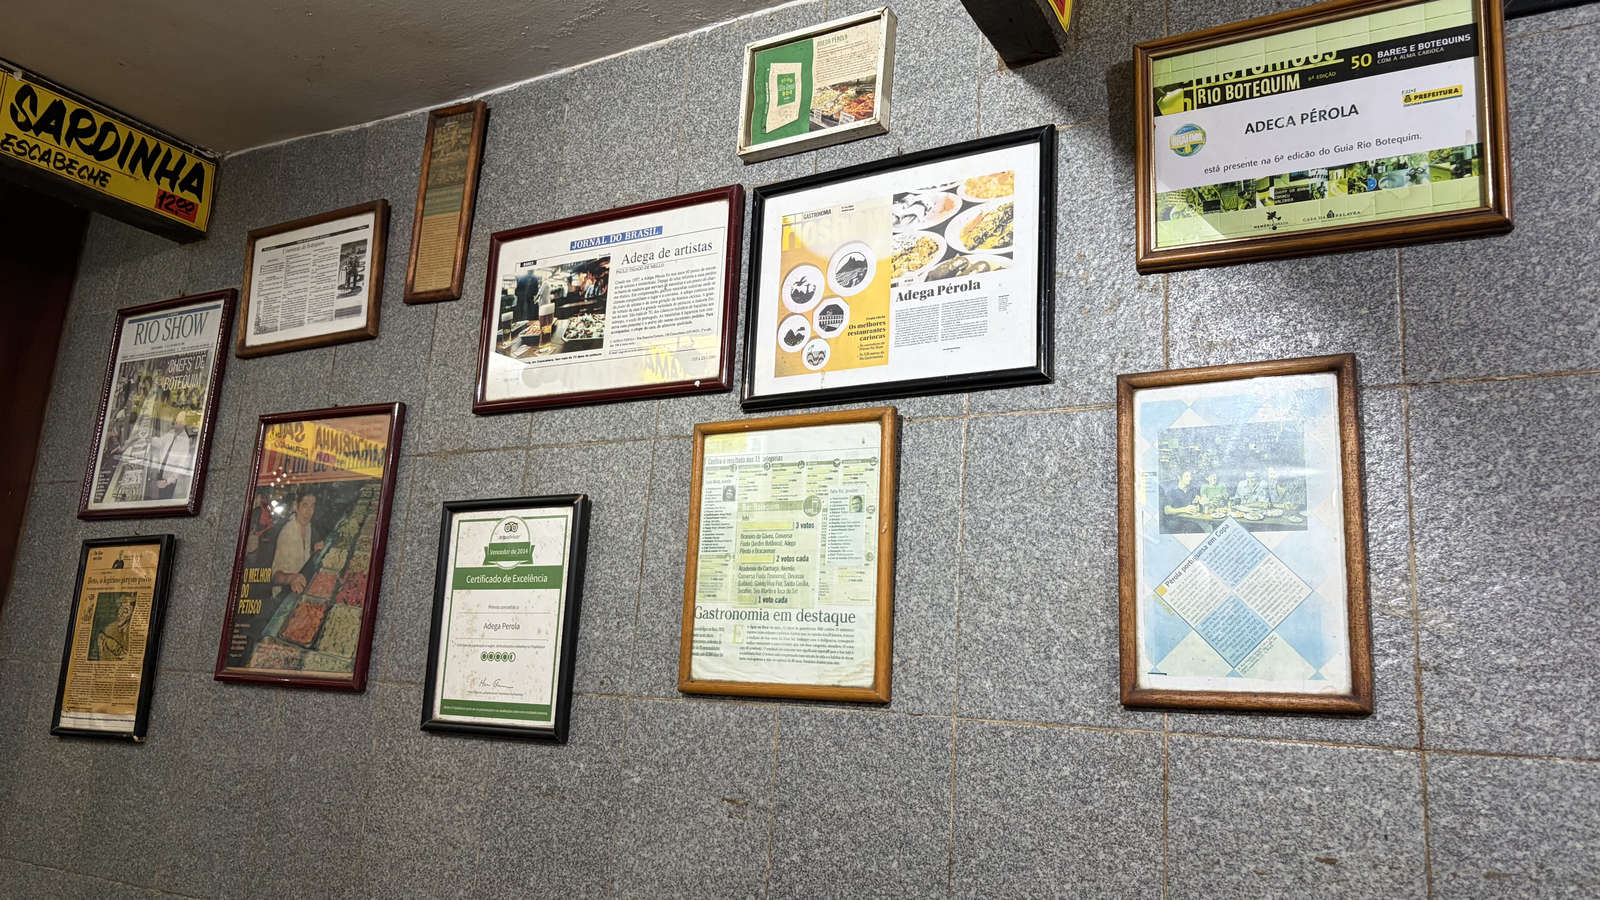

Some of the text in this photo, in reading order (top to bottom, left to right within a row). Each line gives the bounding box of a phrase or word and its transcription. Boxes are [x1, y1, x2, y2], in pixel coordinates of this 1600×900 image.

[1377, 33, 1472, 59] BARES E BOTEQUINS
[1351, 53, 1373, 70] 50
[1377, 57, 1392, 65] COM
[1400, 53, 1417, 61] ALMA
[1418, 47, 1445, 58] CARIOCA
[1197, 86, 1222, 106] RIO
[1225, 73, 1300, 102] BOTEQUIM
[1413, 87, 1460, 101] PREFEITURA
[1300, 103, 1360, 125] PÉROLA
[10, 84, 206, 204] SARDINHA
[0, 132, 113, 189] ESCABECHE
[1204, 164, 1221, 175] está
[1223, 158, 1258, 174] presente
[1261, 157, 1272, 166] na
[1318, 147, 1331, 157] do
[1333, 143, 1354, 154] Guia
[1356, 139, 1372, 150] Rio
[1375, 132, 1422, 148] Botequim.
[571, 226, 660, 250] JORNAL DO BRASIL
[621, 241, 713, 266] Adega de artistas
[895, 280, 982, 303] Adega Pérola
[134, 312, 210, 346] RIO SHOW
[847, 327, 887, 337] restaurantes
[857, 320, 887, 330] melhores
[859, 333, 886, 342] cariocas
[195, 354, 207, 369] DE
[800, 521, 815, 530] votos
[243, 567, 273, 583] O MELHOR
[466, 572, 548, 586] Certificado de Excelência
[240, 584, 250, 599] DO
[762, 596, 774, 604] voto
[774, 596, 788, 604] cada
[238, 599, 263, 615] PETISCO
[694, 605, 856, 627] Gastronomia em destaque
[483, 621, 521, 632] Adega Perola
